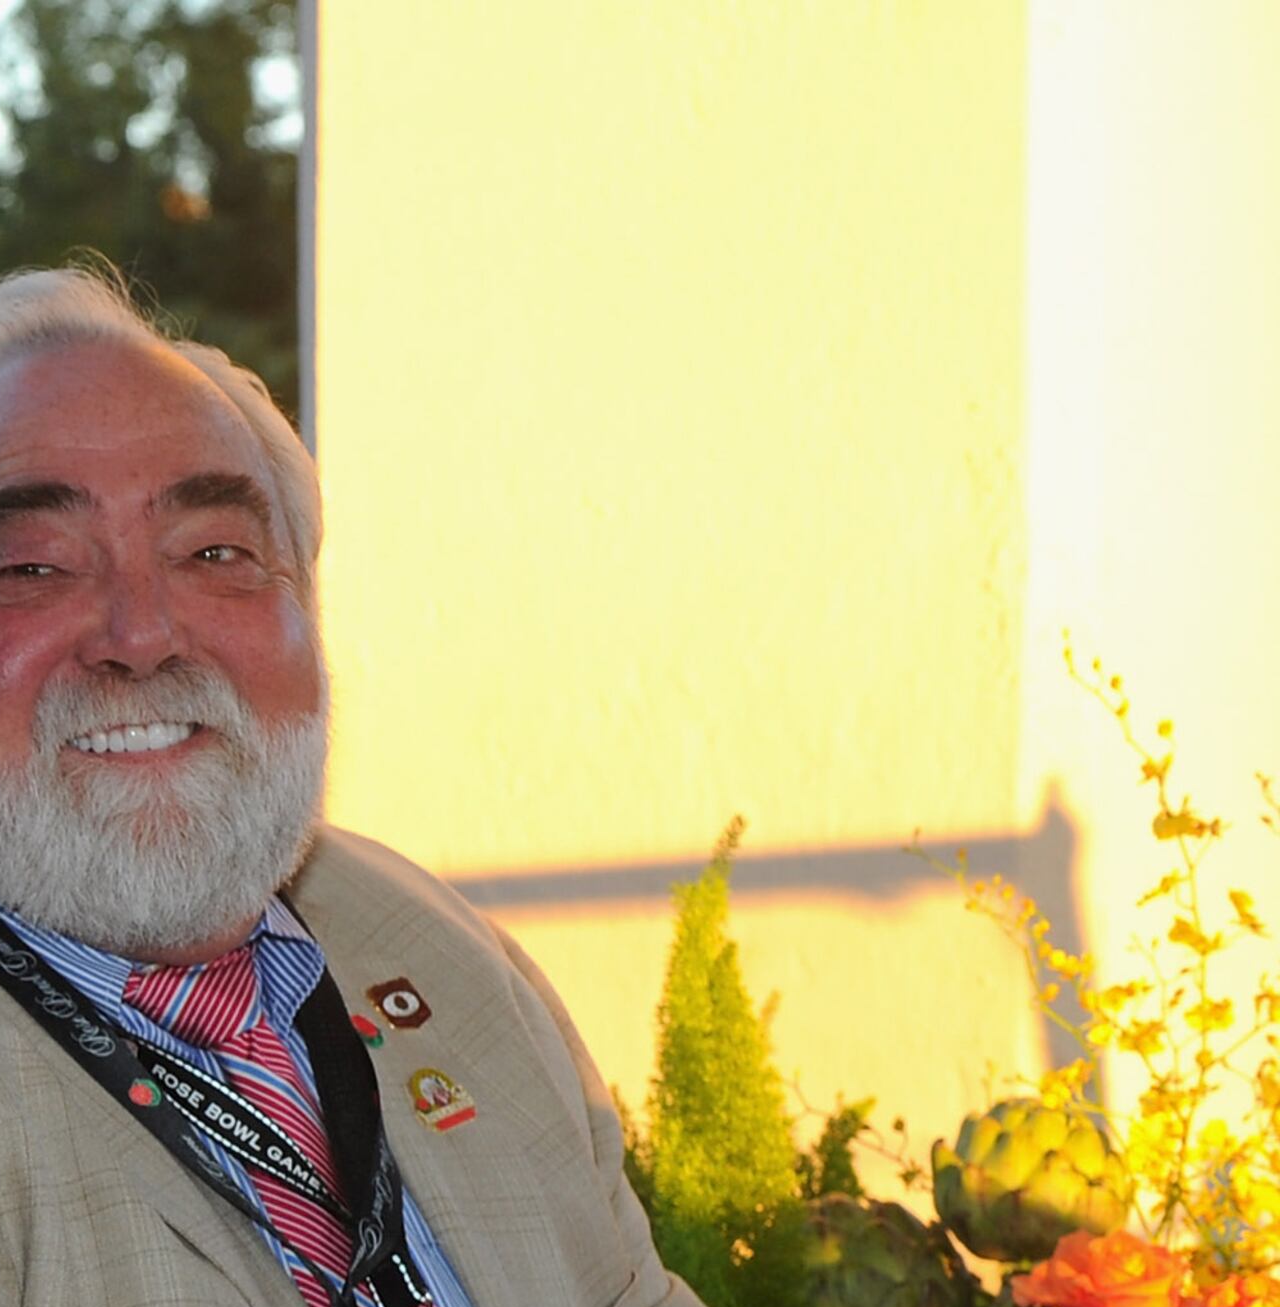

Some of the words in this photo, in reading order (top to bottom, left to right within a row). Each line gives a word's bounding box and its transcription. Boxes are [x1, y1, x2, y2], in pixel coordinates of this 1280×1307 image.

[70, 1015, 116, 1057] Rose
[152, 1064, 205, 1109] ROSE
[204, 1103, 261, 1151] BOWL
[267, 1145, 321, 1190] GAME
